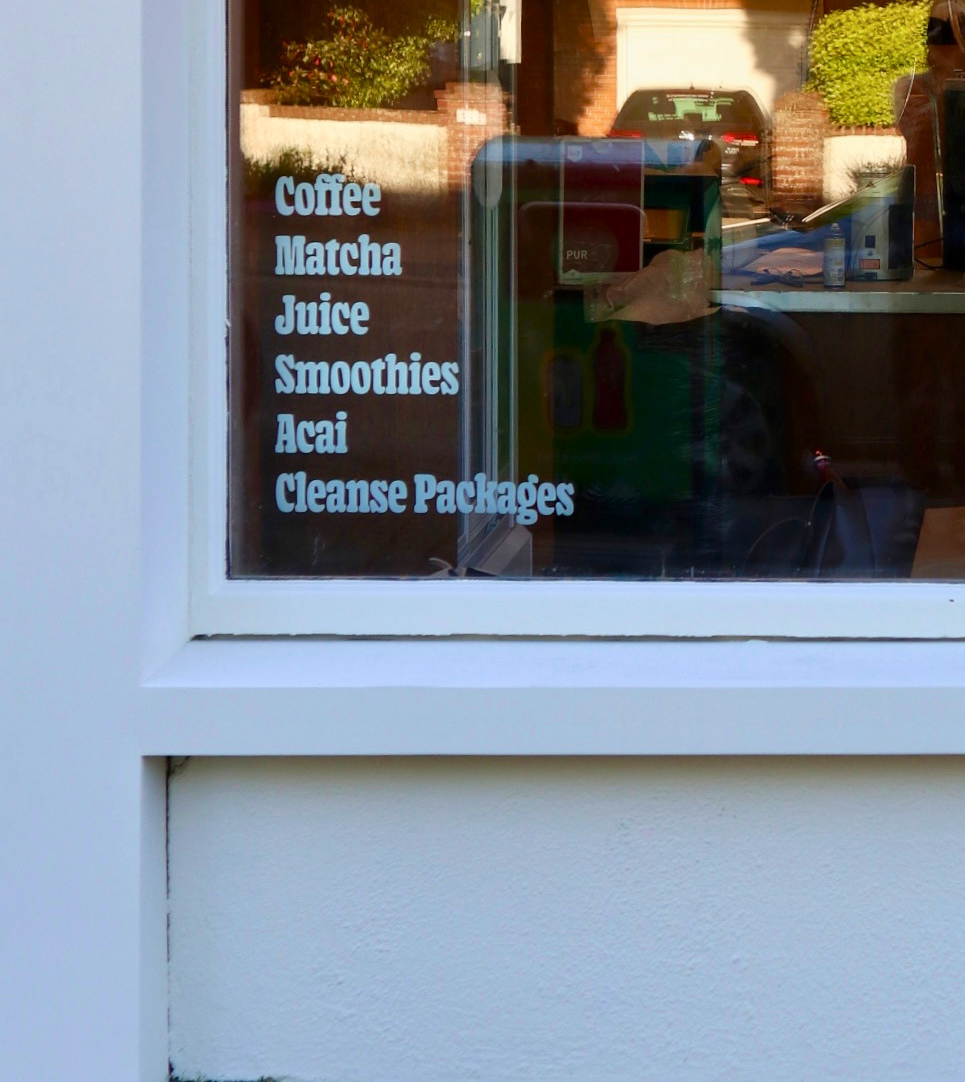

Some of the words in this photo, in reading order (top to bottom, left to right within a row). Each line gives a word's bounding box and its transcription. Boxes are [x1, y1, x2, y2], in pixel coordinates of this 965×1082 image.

[274, 172, 382, 217] Coffee
[274, 233, 403, 276] Matcha
[274, 292, 370, 336] Juice
[274, 352, 459, 396] Smoothies
[274, 411, 348, 454] Acai
[275, 471, 408, 514] Cleanse
[413, 472, 575, 526] Packages
